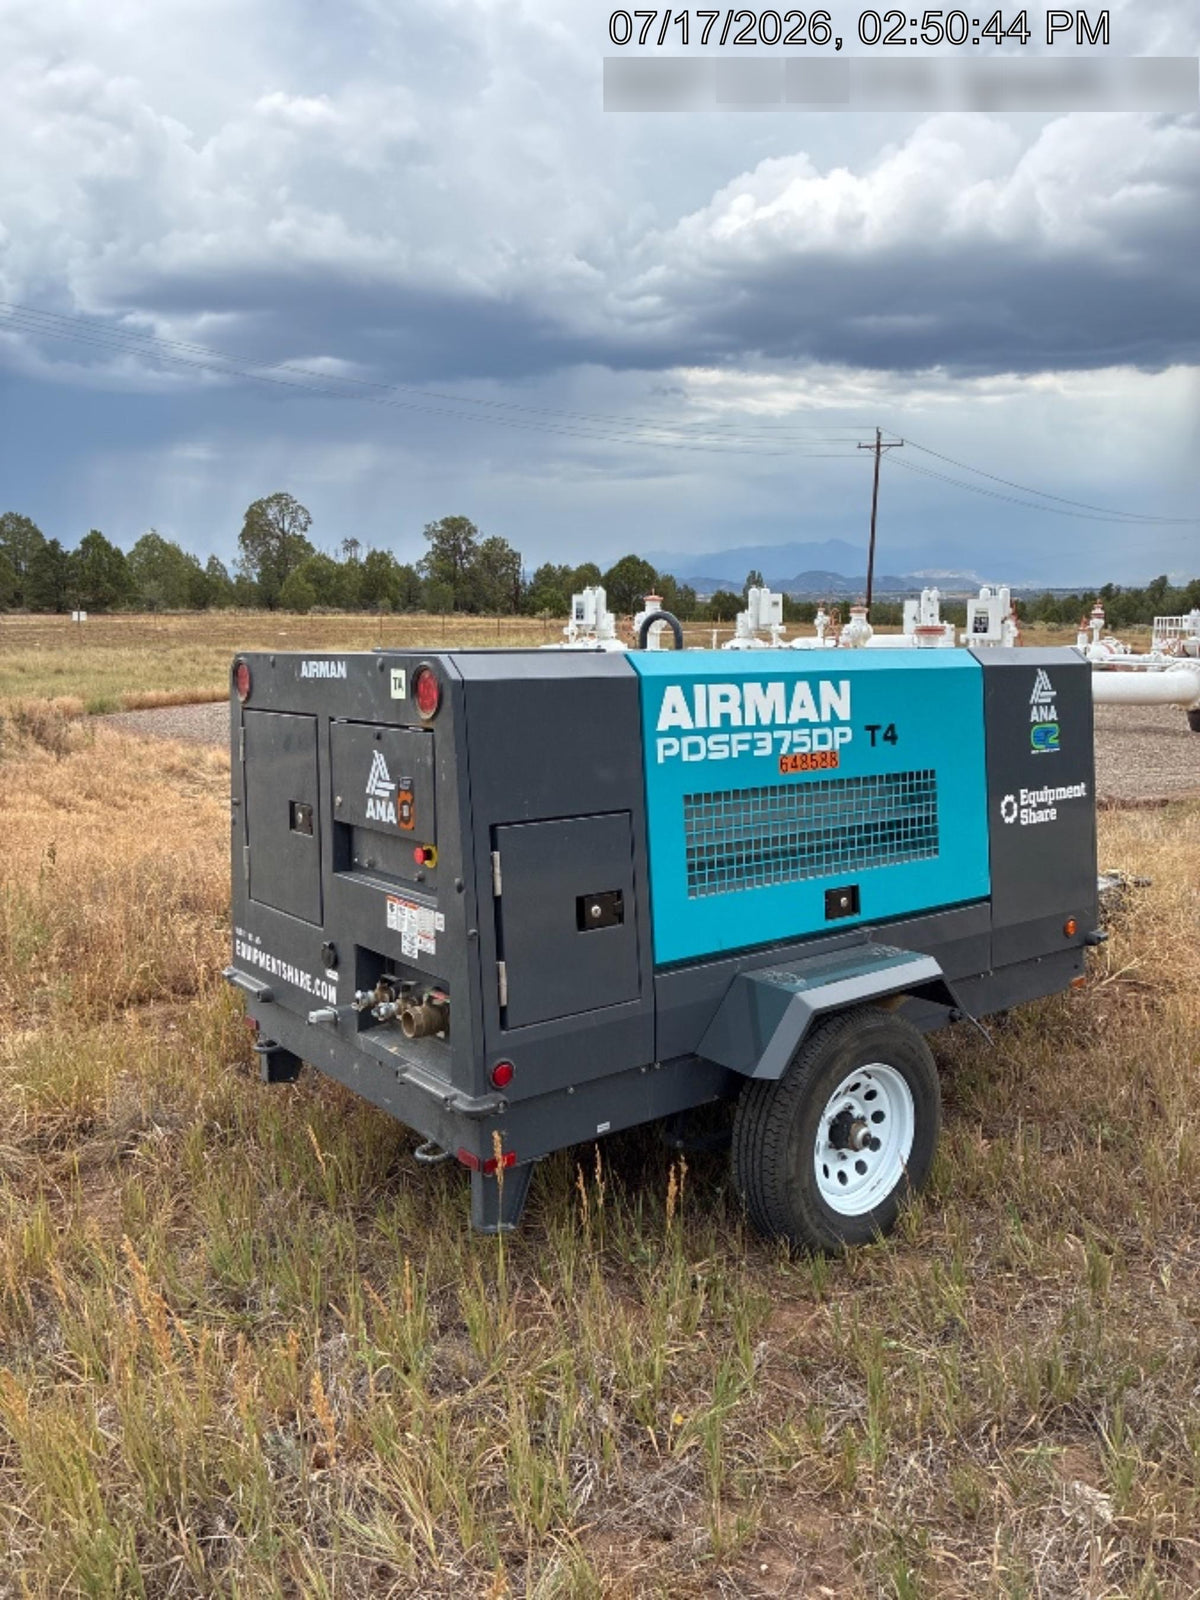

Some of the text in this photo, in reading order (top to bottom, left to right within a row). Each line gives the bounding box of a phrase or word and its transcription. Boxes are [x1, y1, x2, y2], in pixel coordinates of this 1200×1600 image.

[300, 661, 347, 679] AIRMAN
[656, 680, 851, 731] AIRMAN
[1030, 705, 1058, 722] ANA
[656, 723, 898, 764] PDSF375DP T4
[1020, 782, 1087, 808] Equipment
[365, 798, 397, 825] ANA
[1020, 808, 1057, 826] Share
